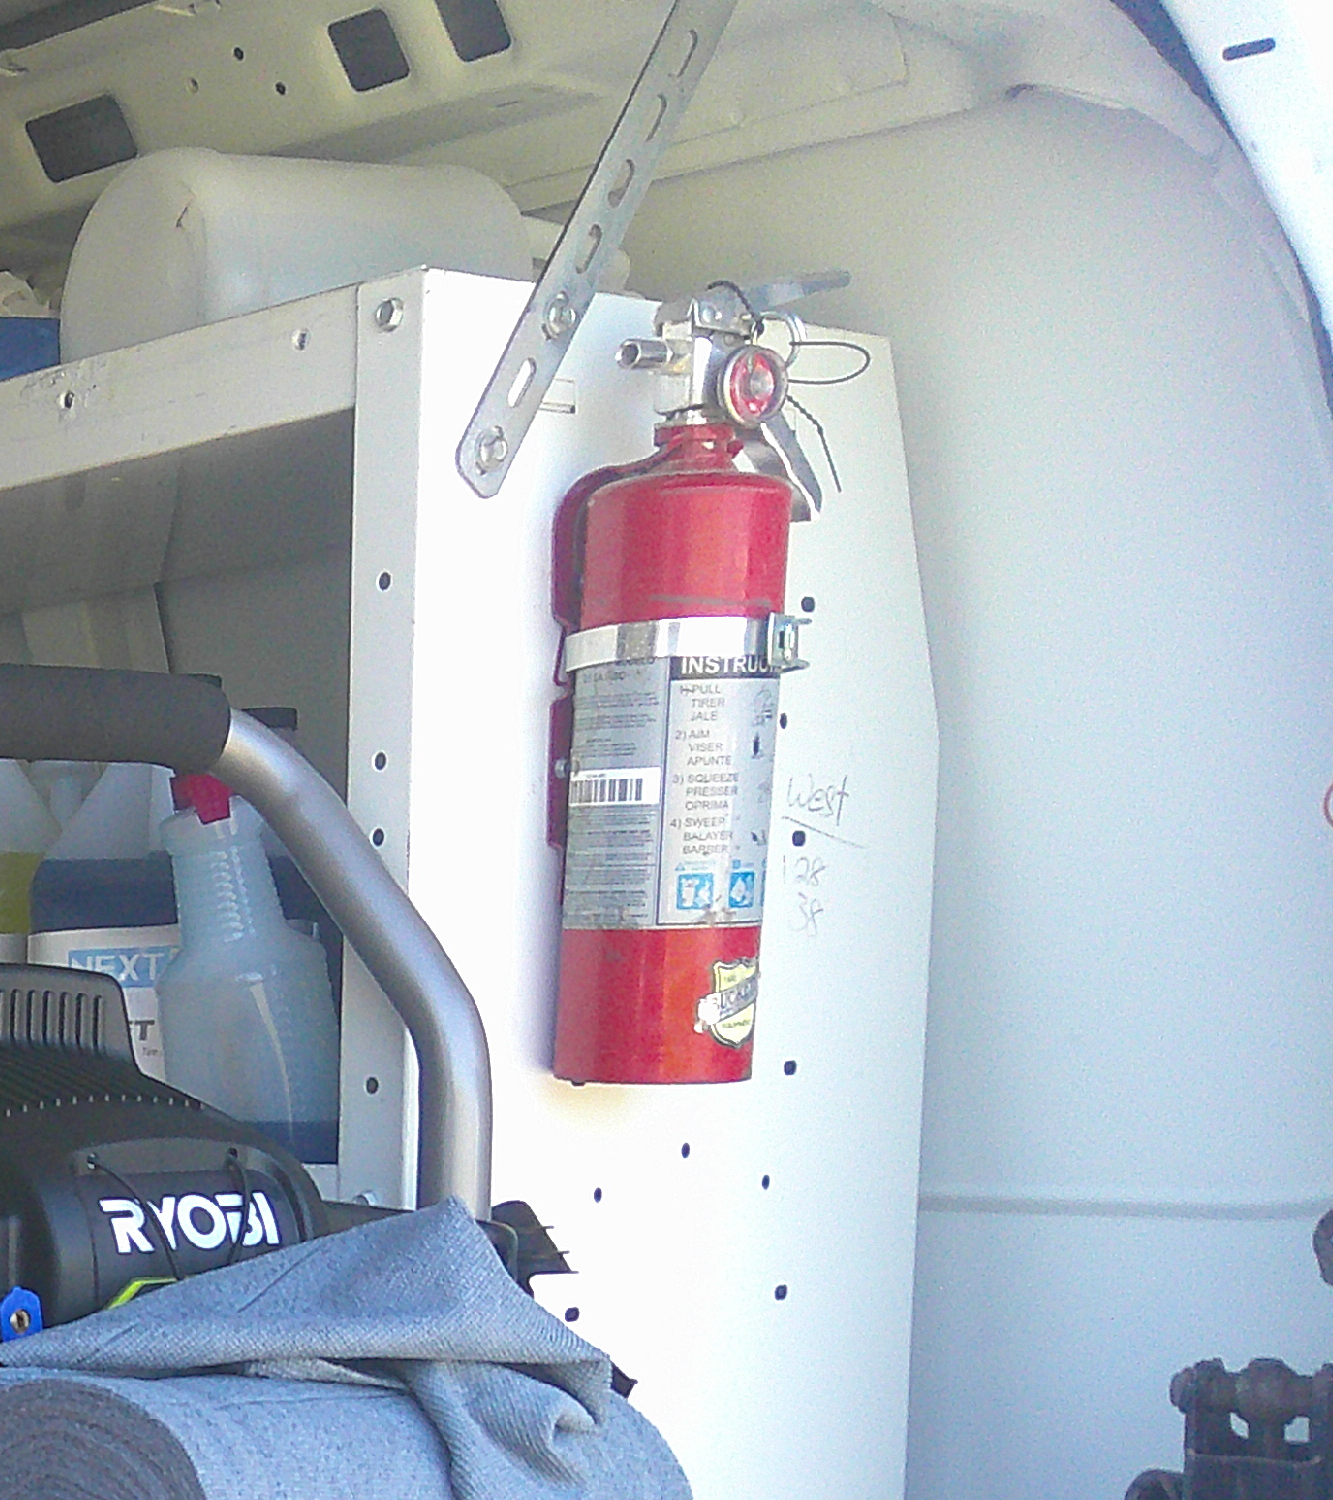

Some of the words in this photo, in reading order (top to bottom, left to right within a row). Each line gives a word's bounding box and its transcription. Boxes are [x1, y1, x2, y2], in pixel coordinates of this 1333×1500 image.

[692, 684, 721, 694] PULL
[691, 698, 725, 709] TIRER
[690, 711, 718, 721] JALE
[688, 729, 710, 739] AIM
[688, 743, 724, 752] VISER
[687, 755, 732, 766] APUNTE
[688, 772, 739, 783] SQUEEZE
[685, 785, 738, 797] PRESSER
[787, 773, 850, 826] West
[684, 816, 725, 829] SWEEP
[99, 1191, 281, 1254] RYOBI
